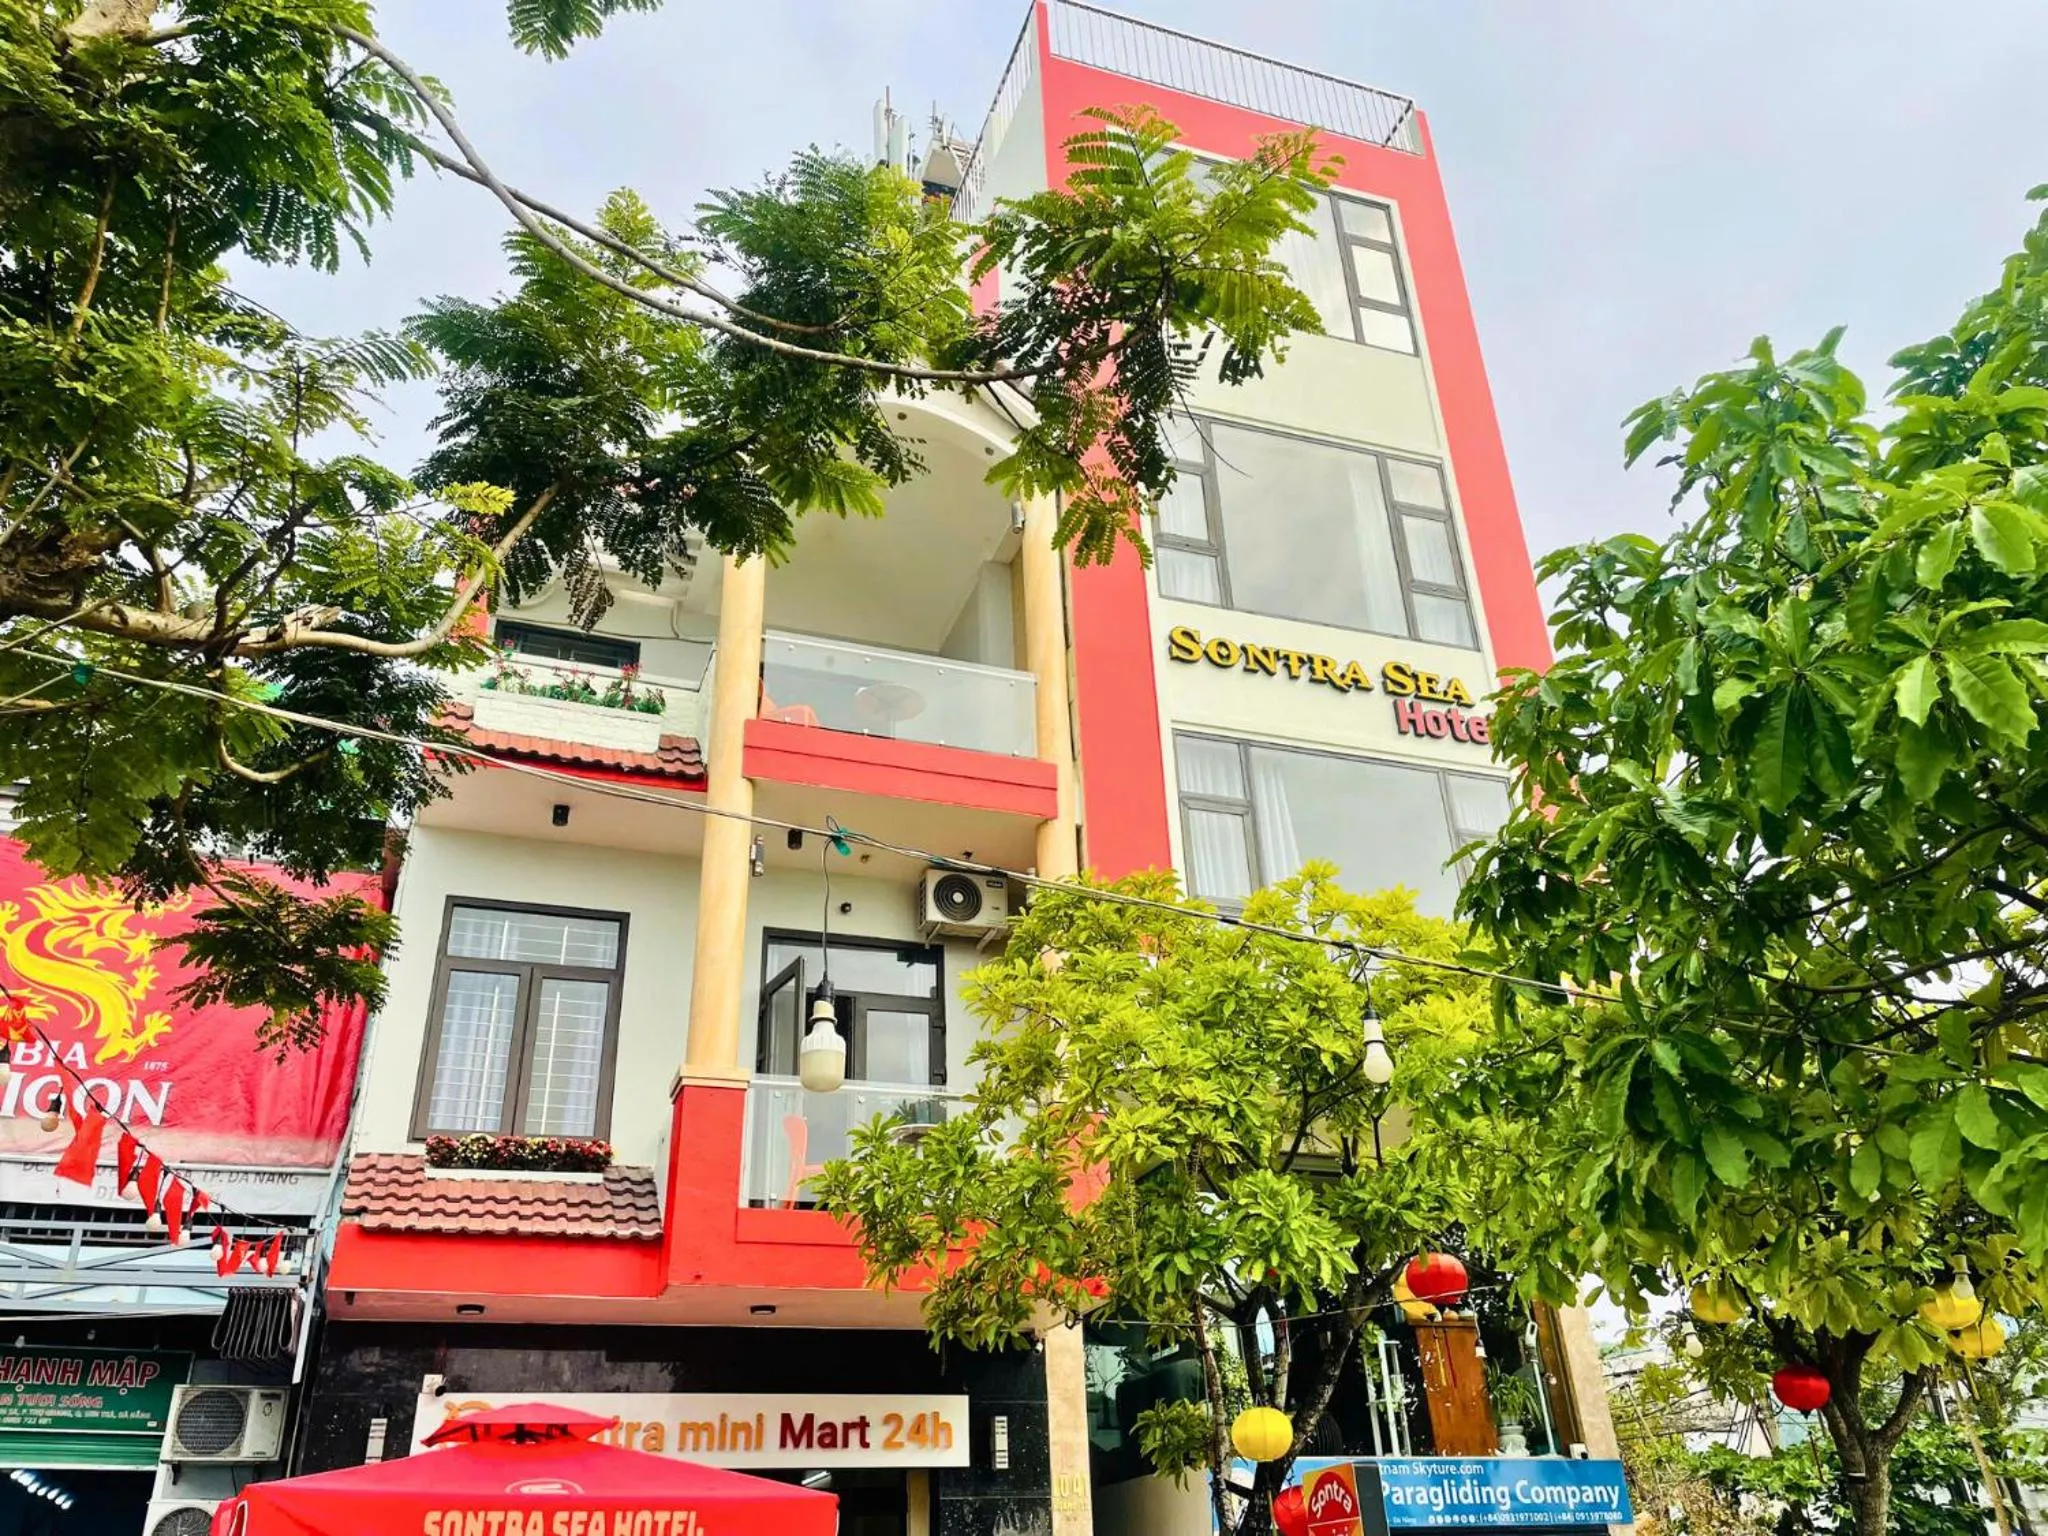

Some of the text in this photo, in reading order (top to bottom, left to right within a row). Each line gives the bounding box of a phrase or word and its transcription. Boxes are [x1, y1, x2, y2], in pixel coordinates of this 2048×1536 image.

[1382, 660, 1475, 707] SEA
[1393, 698, 1491, 745] Hote
[12, 1039, 88, 1070] BIA
[87, 1355, 160, 1396] MẬP
[597, 1411, 953, 1453] tra mini Mart 24h
[1412, 1461, 1485, 1477] Skyture.com
[1515, 1479, 1621, 1509] Company
